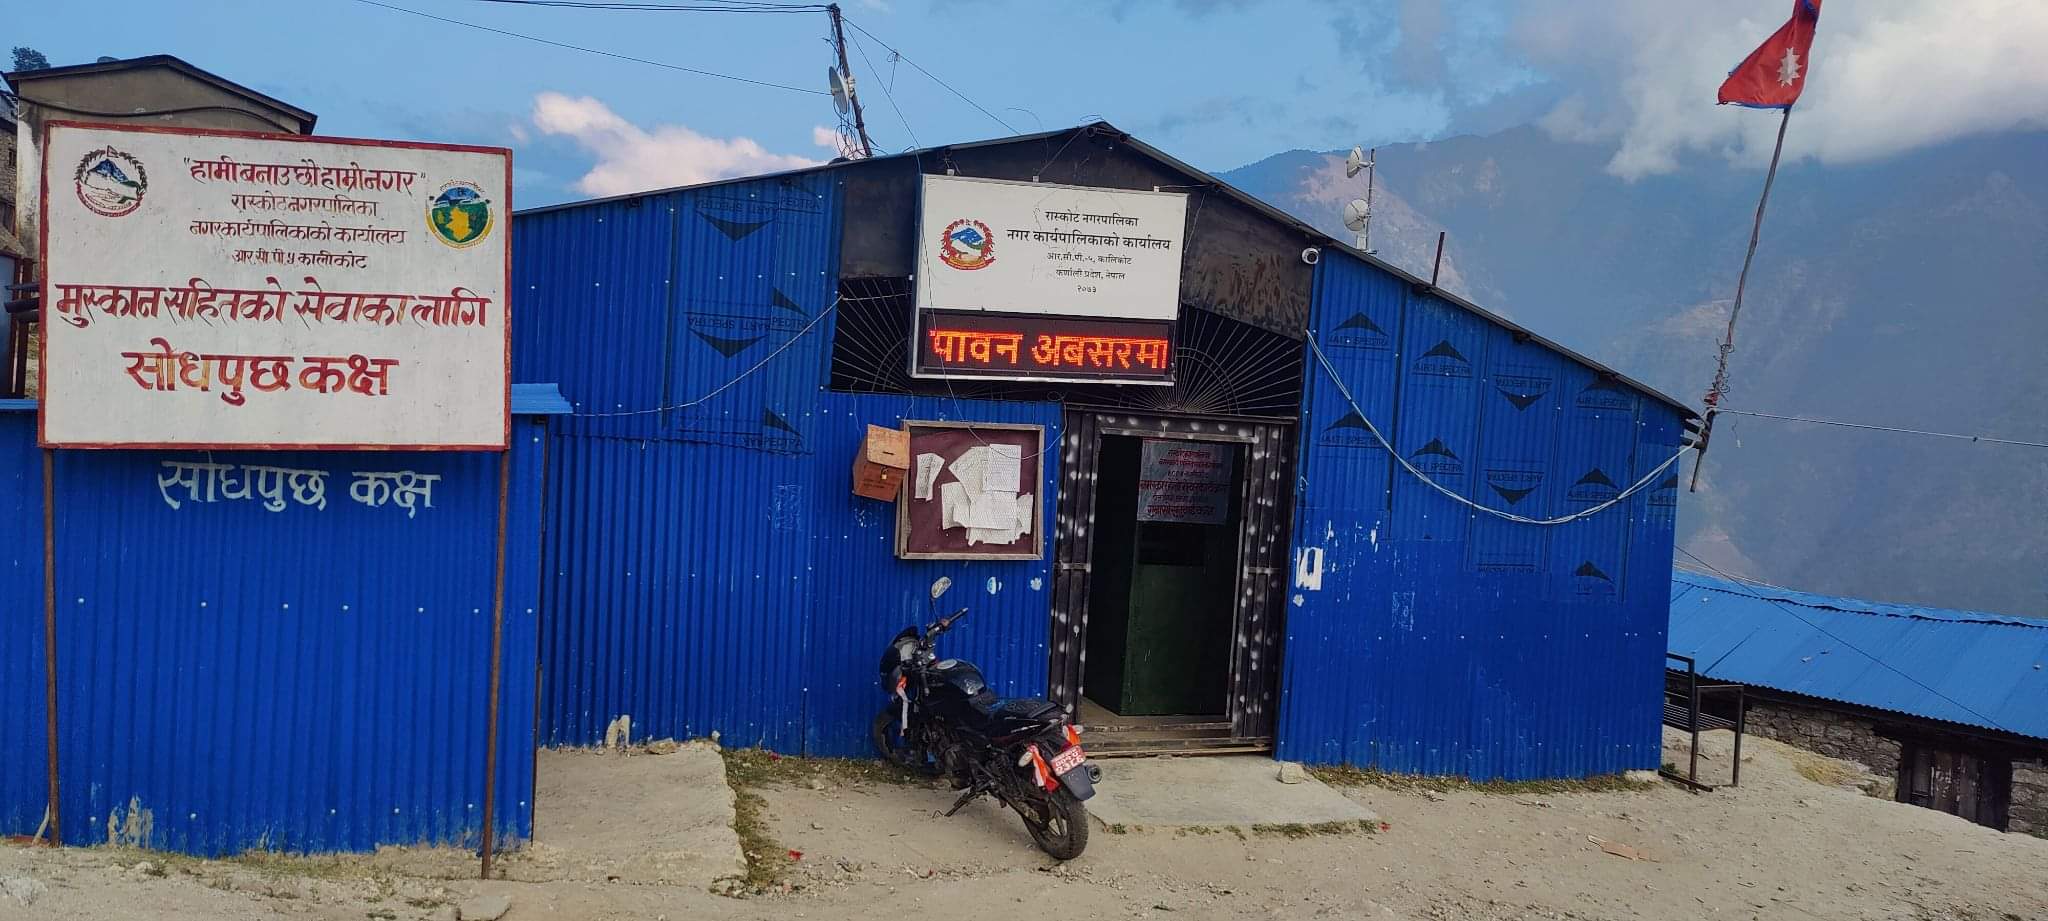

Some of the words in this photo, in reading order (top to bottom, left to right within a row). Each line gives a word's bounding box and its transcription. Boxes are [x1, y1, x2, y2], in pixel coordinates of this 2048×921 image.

[333, 225, 408, 245] कार्यालय
[1045, 209, 1080, 224] रास्कोट
[1082, 213, 1139, 227] नगरपालिका
[1007, 229, 1030, 241] नगर
[1033, 228, 1120, 246] कार्यपालिकाको
[1122, 235, 1171, 249] कार्यालय
[412, 286, 492, 327] लागि
[929, 330, 1024, 363] पावन
[1031, 335, 1168, 369] अबसरमा
[121, 337, 294, 406] सोधपुछ
[299, 354, 399, 397] कक्ष
[350, 470, 441, 519] कक्ष
